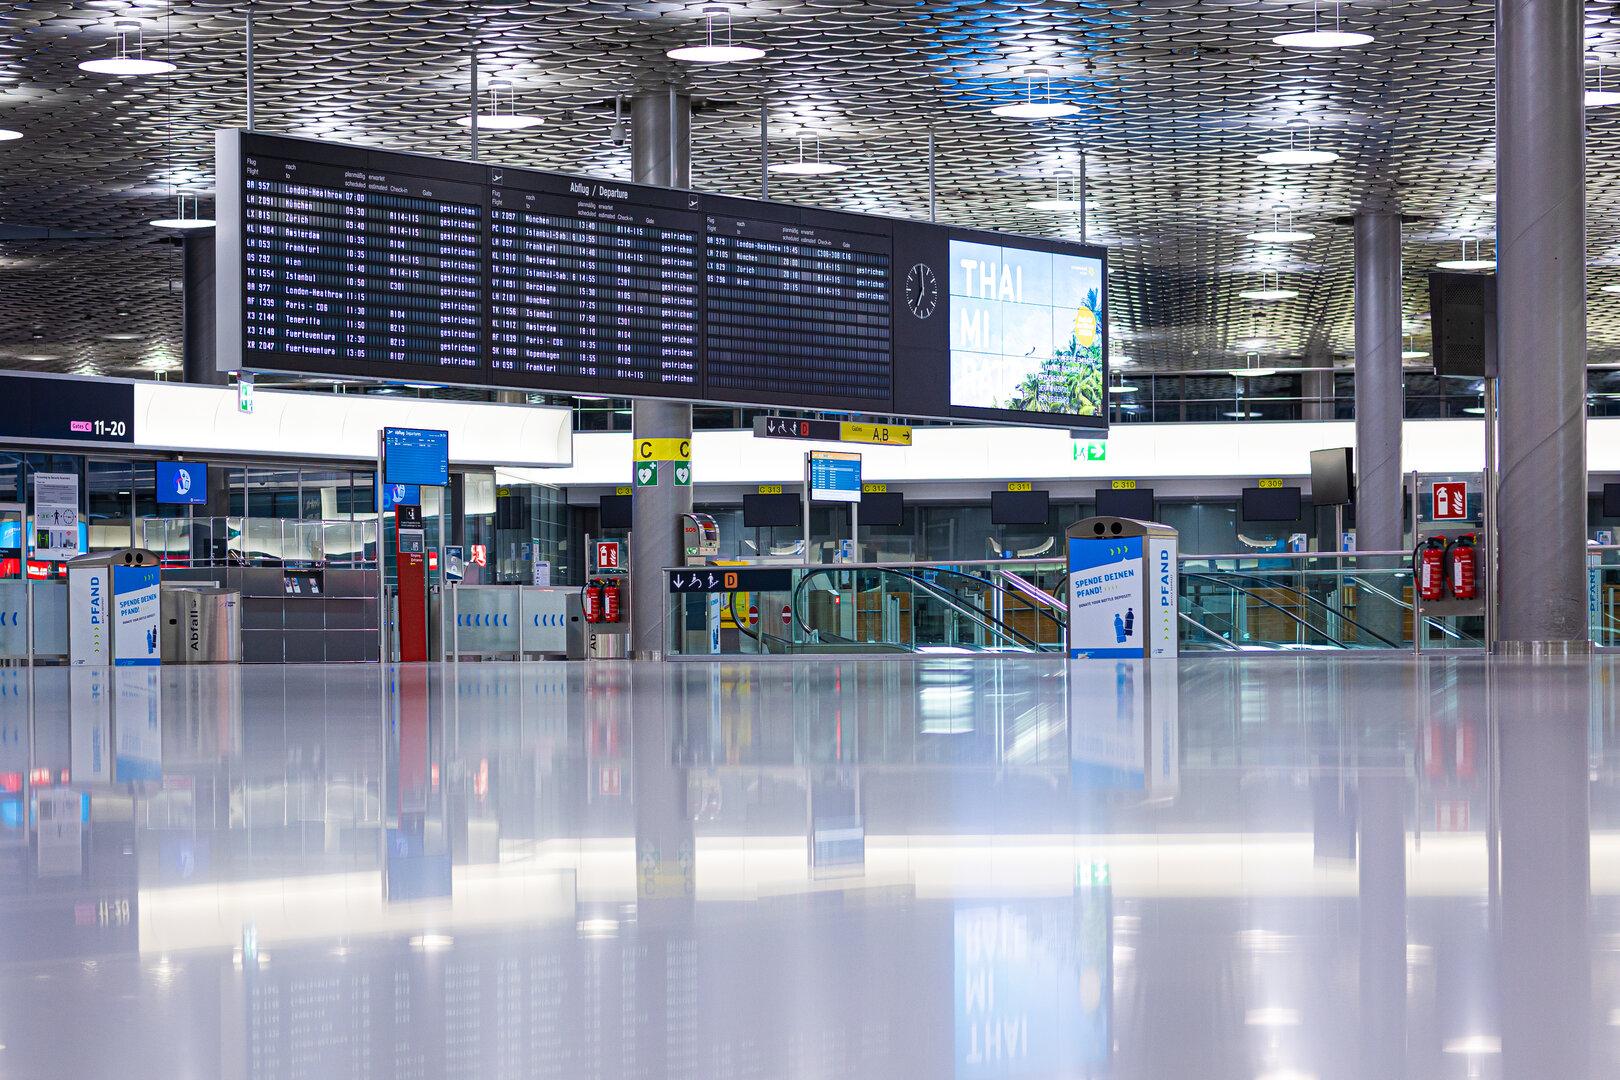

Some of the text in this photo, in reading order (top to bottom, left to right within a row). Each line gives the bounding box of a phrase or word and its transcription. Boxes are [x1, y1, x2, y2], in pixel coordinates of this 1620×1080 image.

[246, 180, 476, 217] BA 957 London-Heathrow 07:00 gestrichen
[570, 182, 628, 200] Abflug Departure
[246, 195, 255, 203] LH
[258, 196, 274, 205] 2091
[285, 200, 312, 210] München
[345, 207, 365, 216] 09:30
[440, 218, 476, 231] gestrichen
[246, 210, 255, 218] LX
[258, 211, 270, 220] 815
[285, 214, 308, 224] Zürich
[345, 221, 365, 230] 09:40
[440, 232, 476, 244] gestrichen
[246, 224, 255, 232] KL
[258, 225, 274, 234] 1904
[285, 228, 320, 240] Amsterdam
[346, 235, 365, 244] 10:35
[440, 246, 476, 258] gestrichen
[246, 239, 255, 247] LH
[258, 240, 270, 248] 053
[285, 243, 320, 254] Frankfurt
[346, 250, 365, 258] 10:35
[440, 260, 476, 272] gestrichen
[258, 254, 270, 263] 292
[285, 257, 301, 266] Wien
[346, 264, 365, 273] 10:40
[440, 273, 476, 285] gestrichen
[246, 268, 255, 276] TK
[258, 269, 274, 278] 1554
[285, 272, 316, 282] Istanbul
[346, 278, 365, 287] 10:50
[440, 287, 476, 299] gestrichen
[960, 258, 1022, 304] THAI
[246, 282, 476, 313] BA 977 London-Heathrow 11:15 gestrichen
[246, 297, 255, 305] AF
[258, 298, 274, 307] 1339
[285, 301, 305, 310] Paris
[346, 306, 365, 315] 11:30
[440, 315, 476, 326] gestrichen
[246, 312, 255, 320] X3
[258, 313, 274, 321] 2144
[285, 315, 320, 325] Teneriffa
[346, 320, 365, 329] 11:50
[440, 329, 476, 340] gestrichen
[246, 326, 255, 334] X3
[258, 327, 274, 336] 2148
[285, 330, 335, 341] Fuerteventura
[346, 335, 365, 343] 12:30
[440, 342, 476, 354] gestrichen
[960, 306, 990, 352] MI
[258, 342, 274, 350] 2047
[285, 344, 335, 355] Fuerteventura
[346, 349, 365, 357] 13:05
[440, 356, 476, 367] gestrichen
[94, 420, 126, 436] 11-20
[803, 424, 808, 434] D
[640, 442, 652, 458] C
[680, 441, 690, 458] C
[768, 485, 780, 493] 313
[872, 484, 886, 492] 312
[728, 574, 734, 586] D
[1075, 569, 1134, 588] SPENDE DEINEN
[1076, 586, 1102, 598] PFAND!
[1161, 550, 1169, 606] PFAND
[90, 576, 100, 624] PFAND
[120, 594, 156, 608] SPENDE DEINEN
